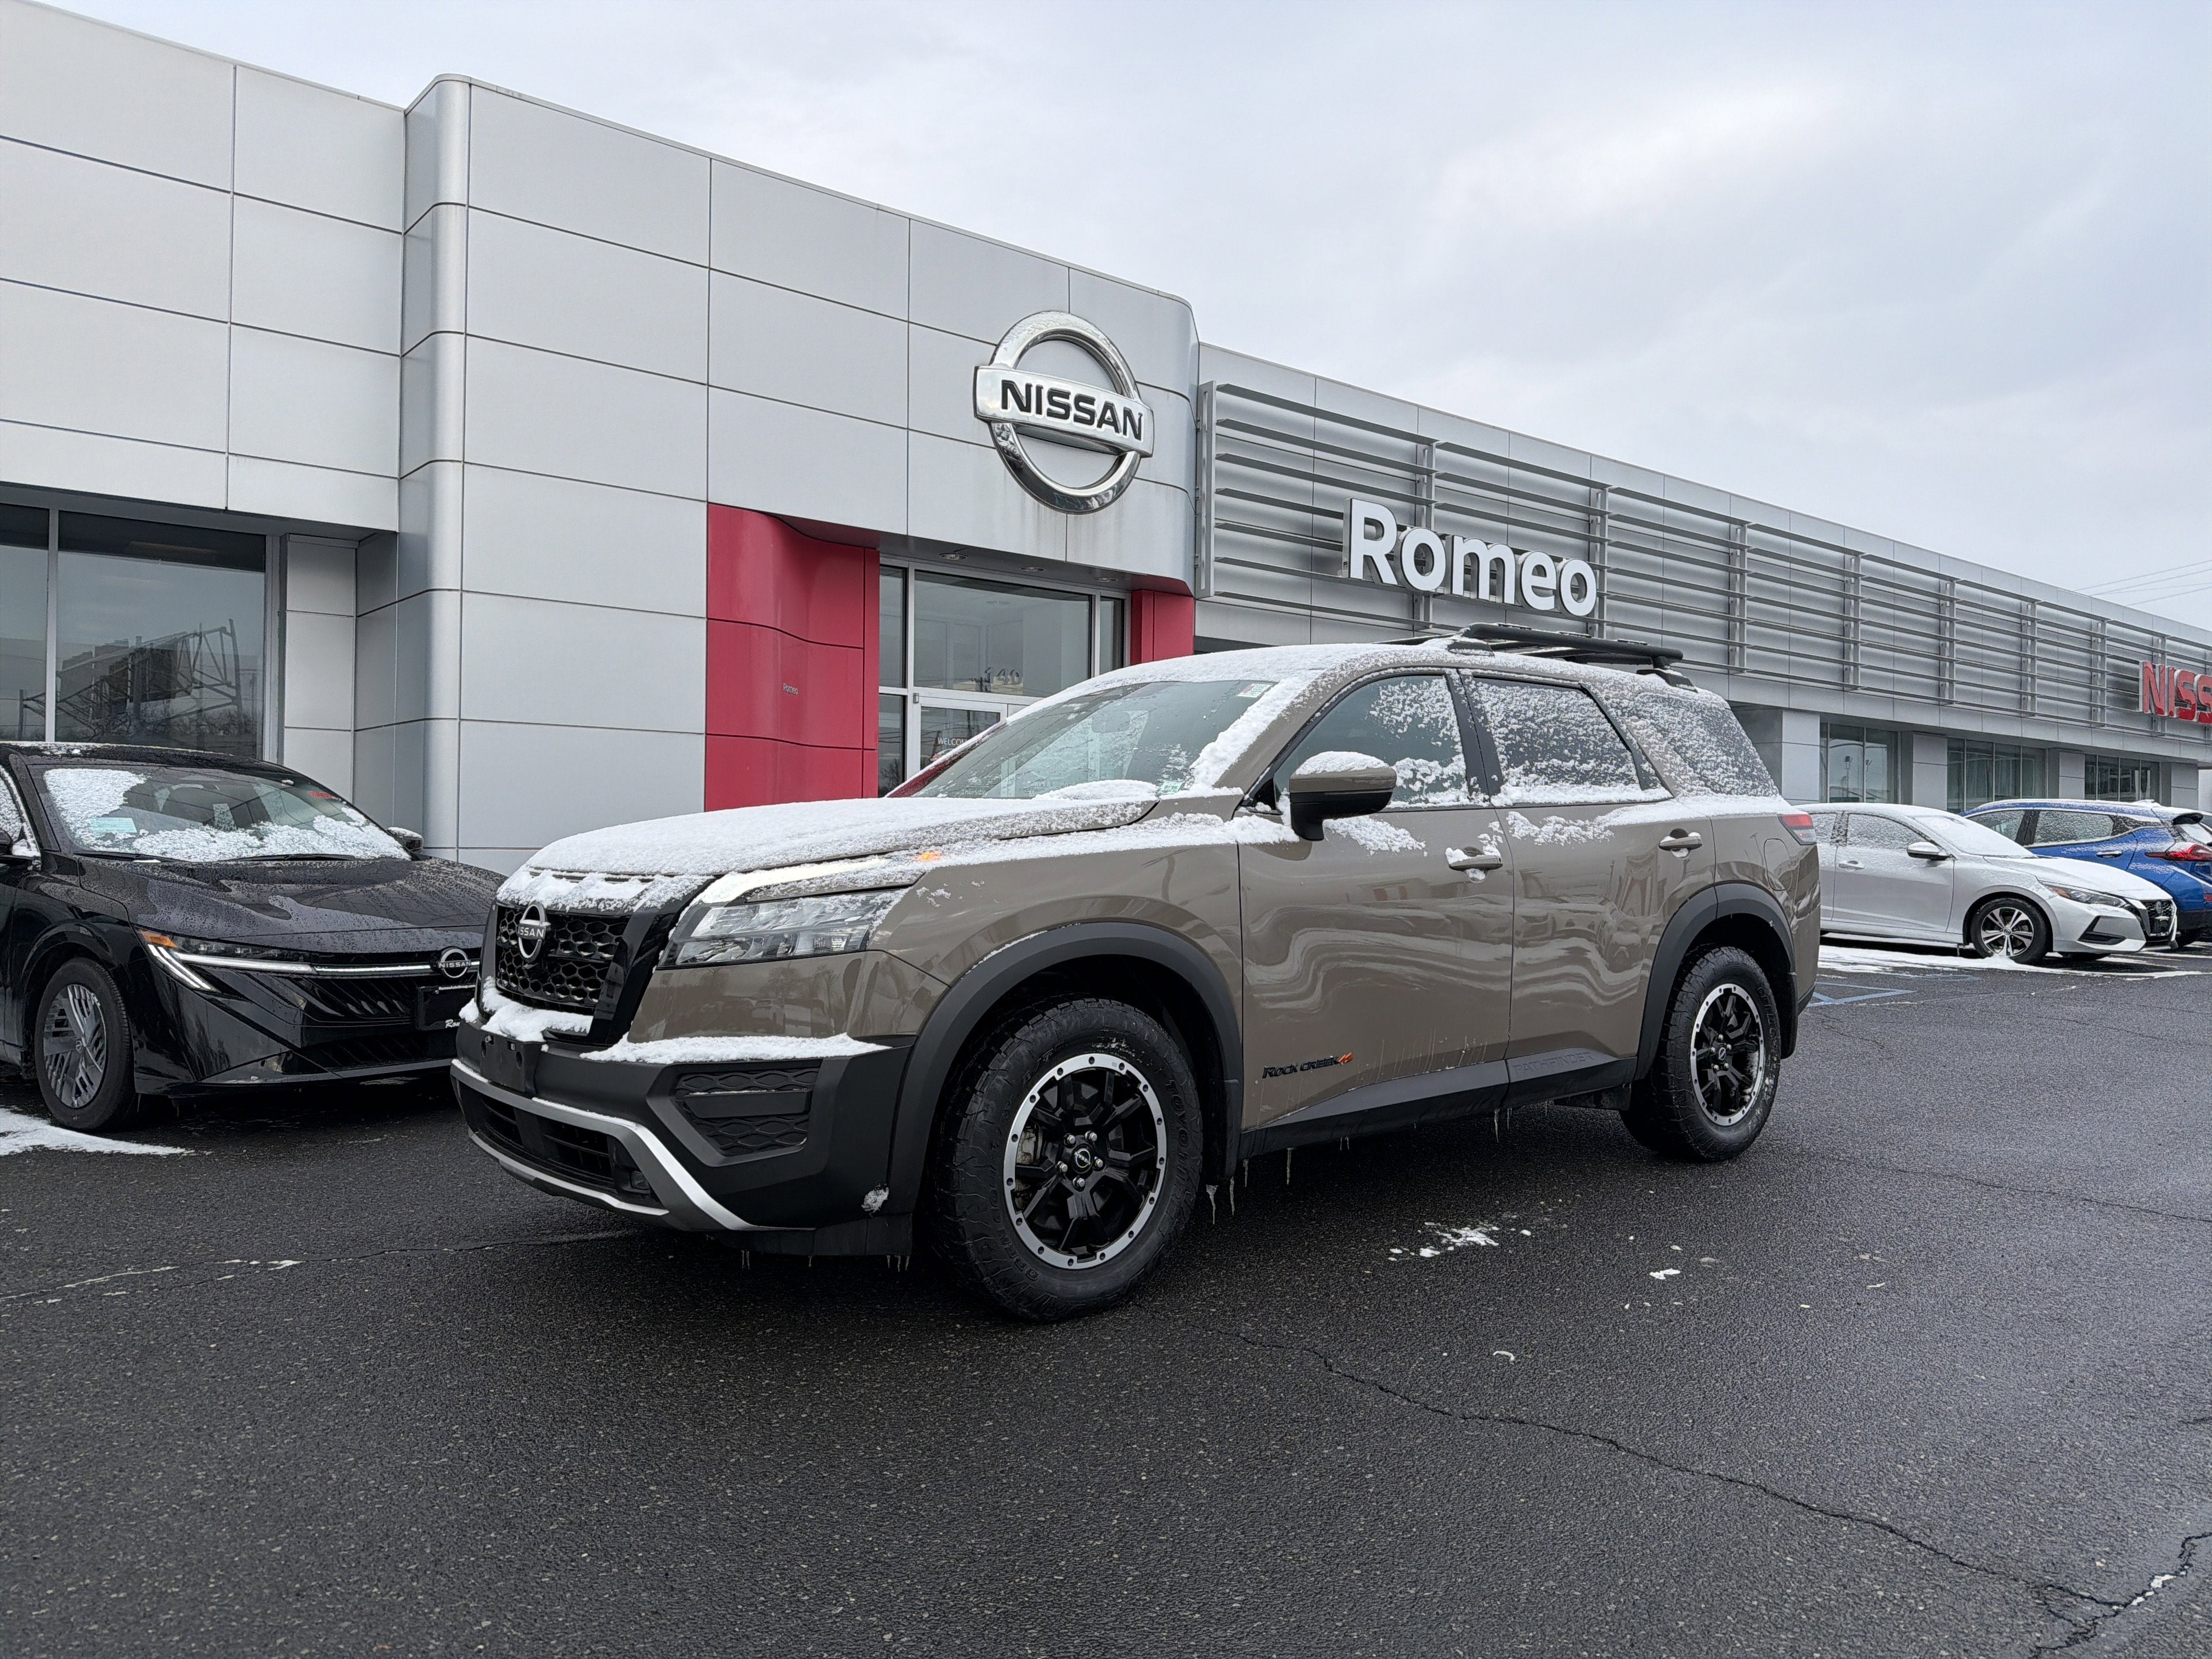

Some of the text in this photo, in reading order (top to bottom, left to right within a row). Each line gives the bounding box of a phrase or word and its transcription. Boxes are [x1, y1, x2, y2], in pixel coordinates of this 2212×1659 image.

[1001, 380, 1143, 441] NISSAN
[1344, 498, 1597, 616] Romeo
[1262, 1057, 1339, 1079] ROCK CREEK
